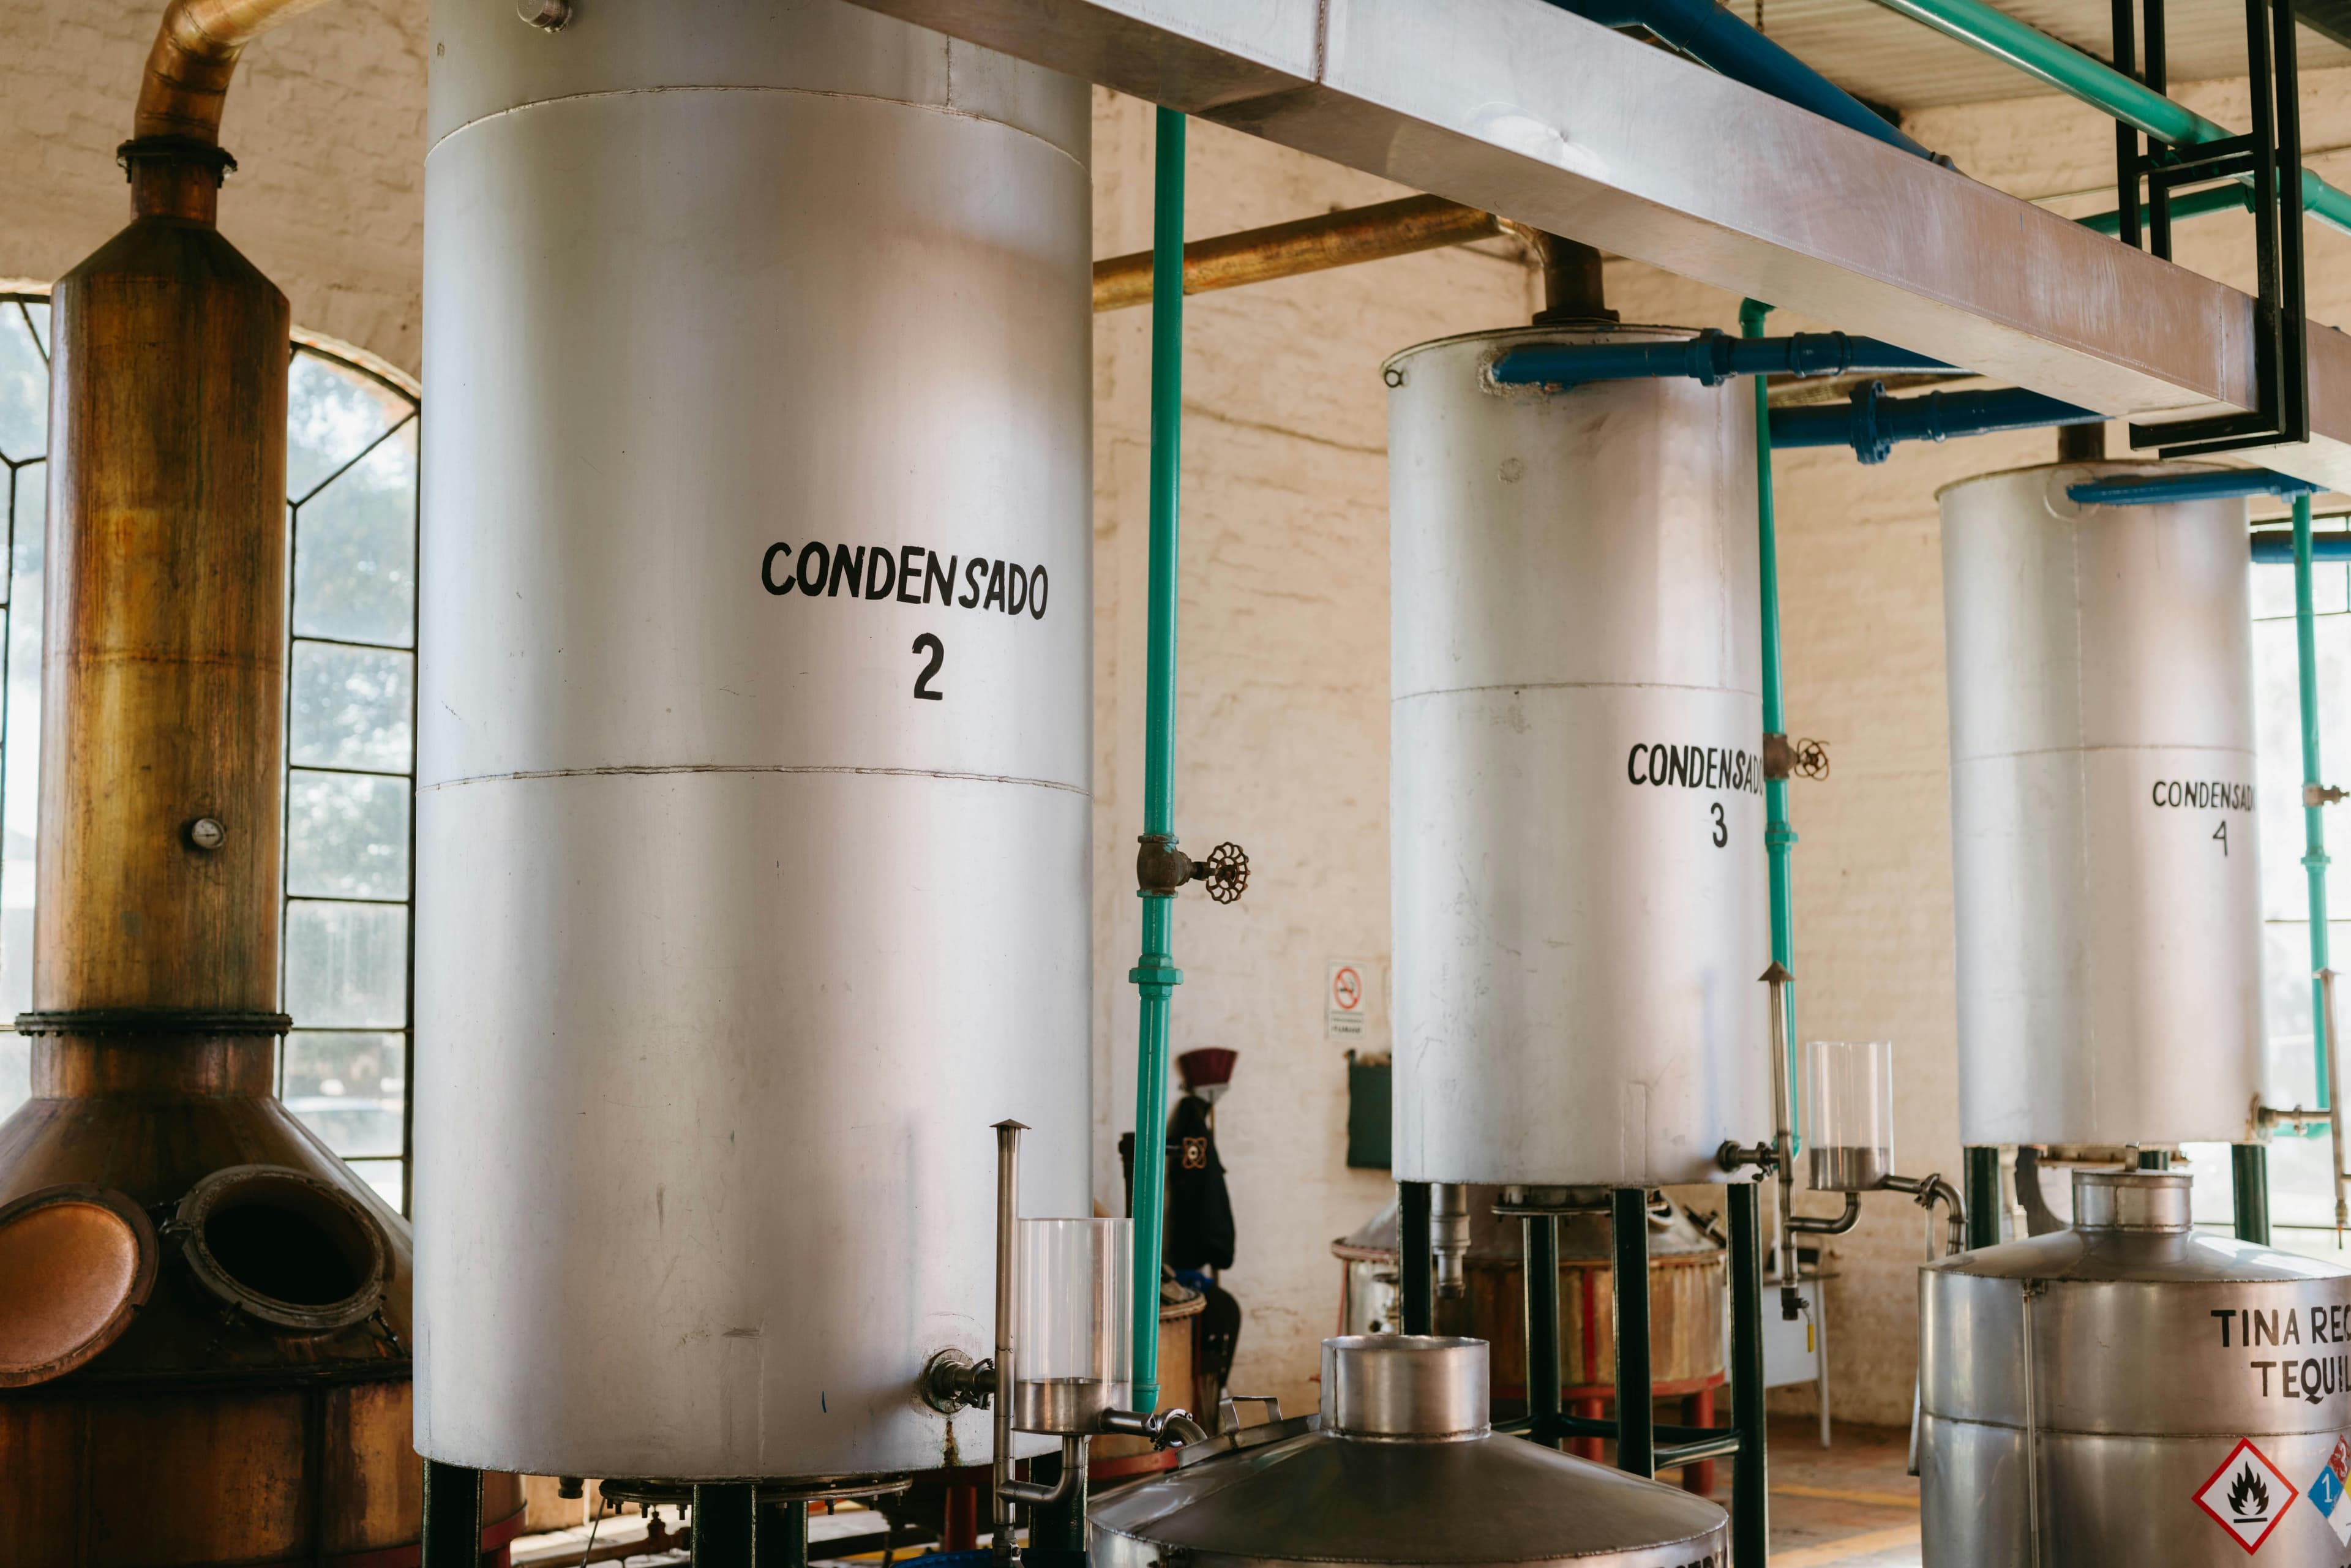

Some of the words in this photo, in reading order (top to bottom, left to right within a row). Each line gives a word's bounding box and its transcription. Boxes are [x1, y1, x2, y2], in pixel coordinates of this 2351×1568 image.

[762, 541, 1048, 620] CONDENSADO
[912, 632, 944, 700] 2
[1711, 802, 1728, 848] 3
[2213, 820, 2227, 857] 4
[2211, 1308, 2300, 1348] TINA
[2251, 1355, 2351, 1405] TEQUIL
[2322, 1473, 2333, 1502] 1
